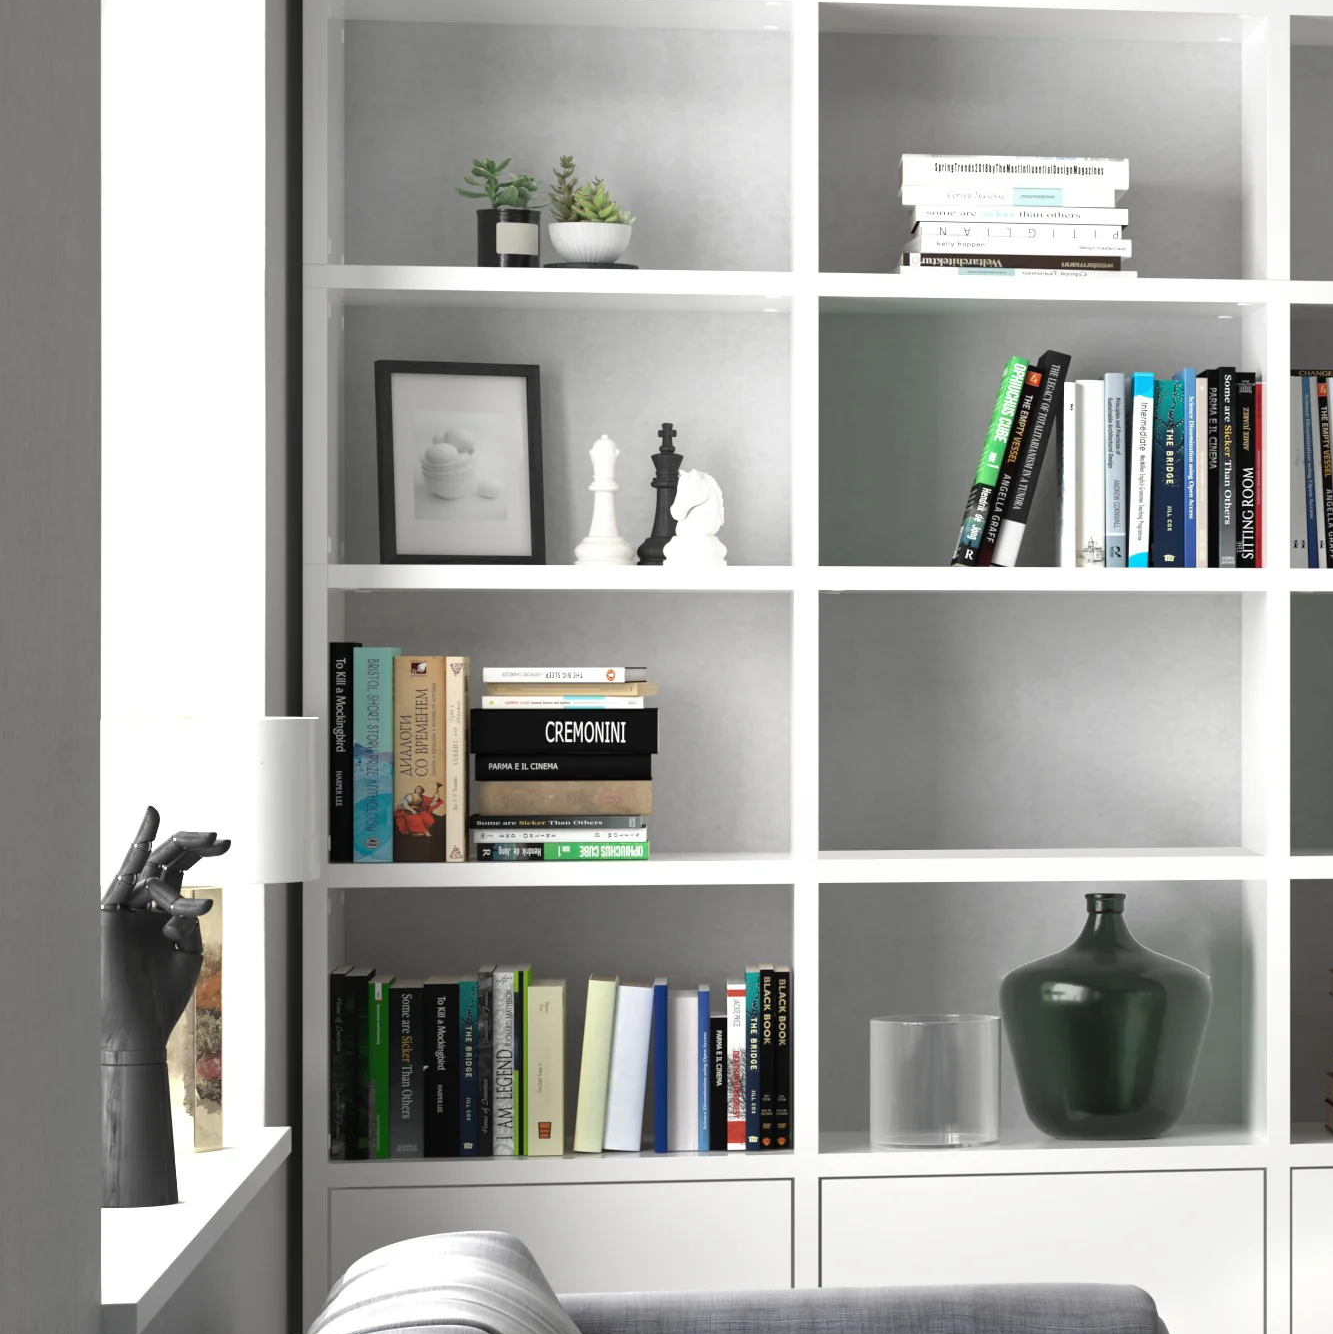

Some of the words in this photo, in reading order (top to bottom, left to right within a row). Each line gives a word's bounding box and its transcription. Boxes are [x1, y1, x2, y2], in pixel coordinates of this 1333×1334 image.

[919, 256, 1003, 268] Weltarchitektur
[1061, 261, 1114, 269] westermann
[415, 688, 429, 753] ВРЕМЕНЕМ
[544, 720, 627, 744] CREMONINI
[400, 715, 413, 777] ДИАЛОГИ
[415, 758, 429, 776] СО
[579, 844, 599, 858] CUBE
[600, 844, 644, 858] OPHIUCHUS
[401, 993, 413, 1018] Some
[763, 976, 771, 1011] BLACK
[778, 978, 787, 1013] BLACK
[401, 1019, 413, 1034] are
[763, 1013, 771, 1045] BOOK
[778, 1015, 787, 1046] BOOK
[401, 1035, 413, 1062] Sicker
[401, 1064, 413, 1088] Than
[495, 1049, 513, 1100] LEGEND
[401, 1089, 413, 1119] Others
[495, 1107, 513, 1129] AM
